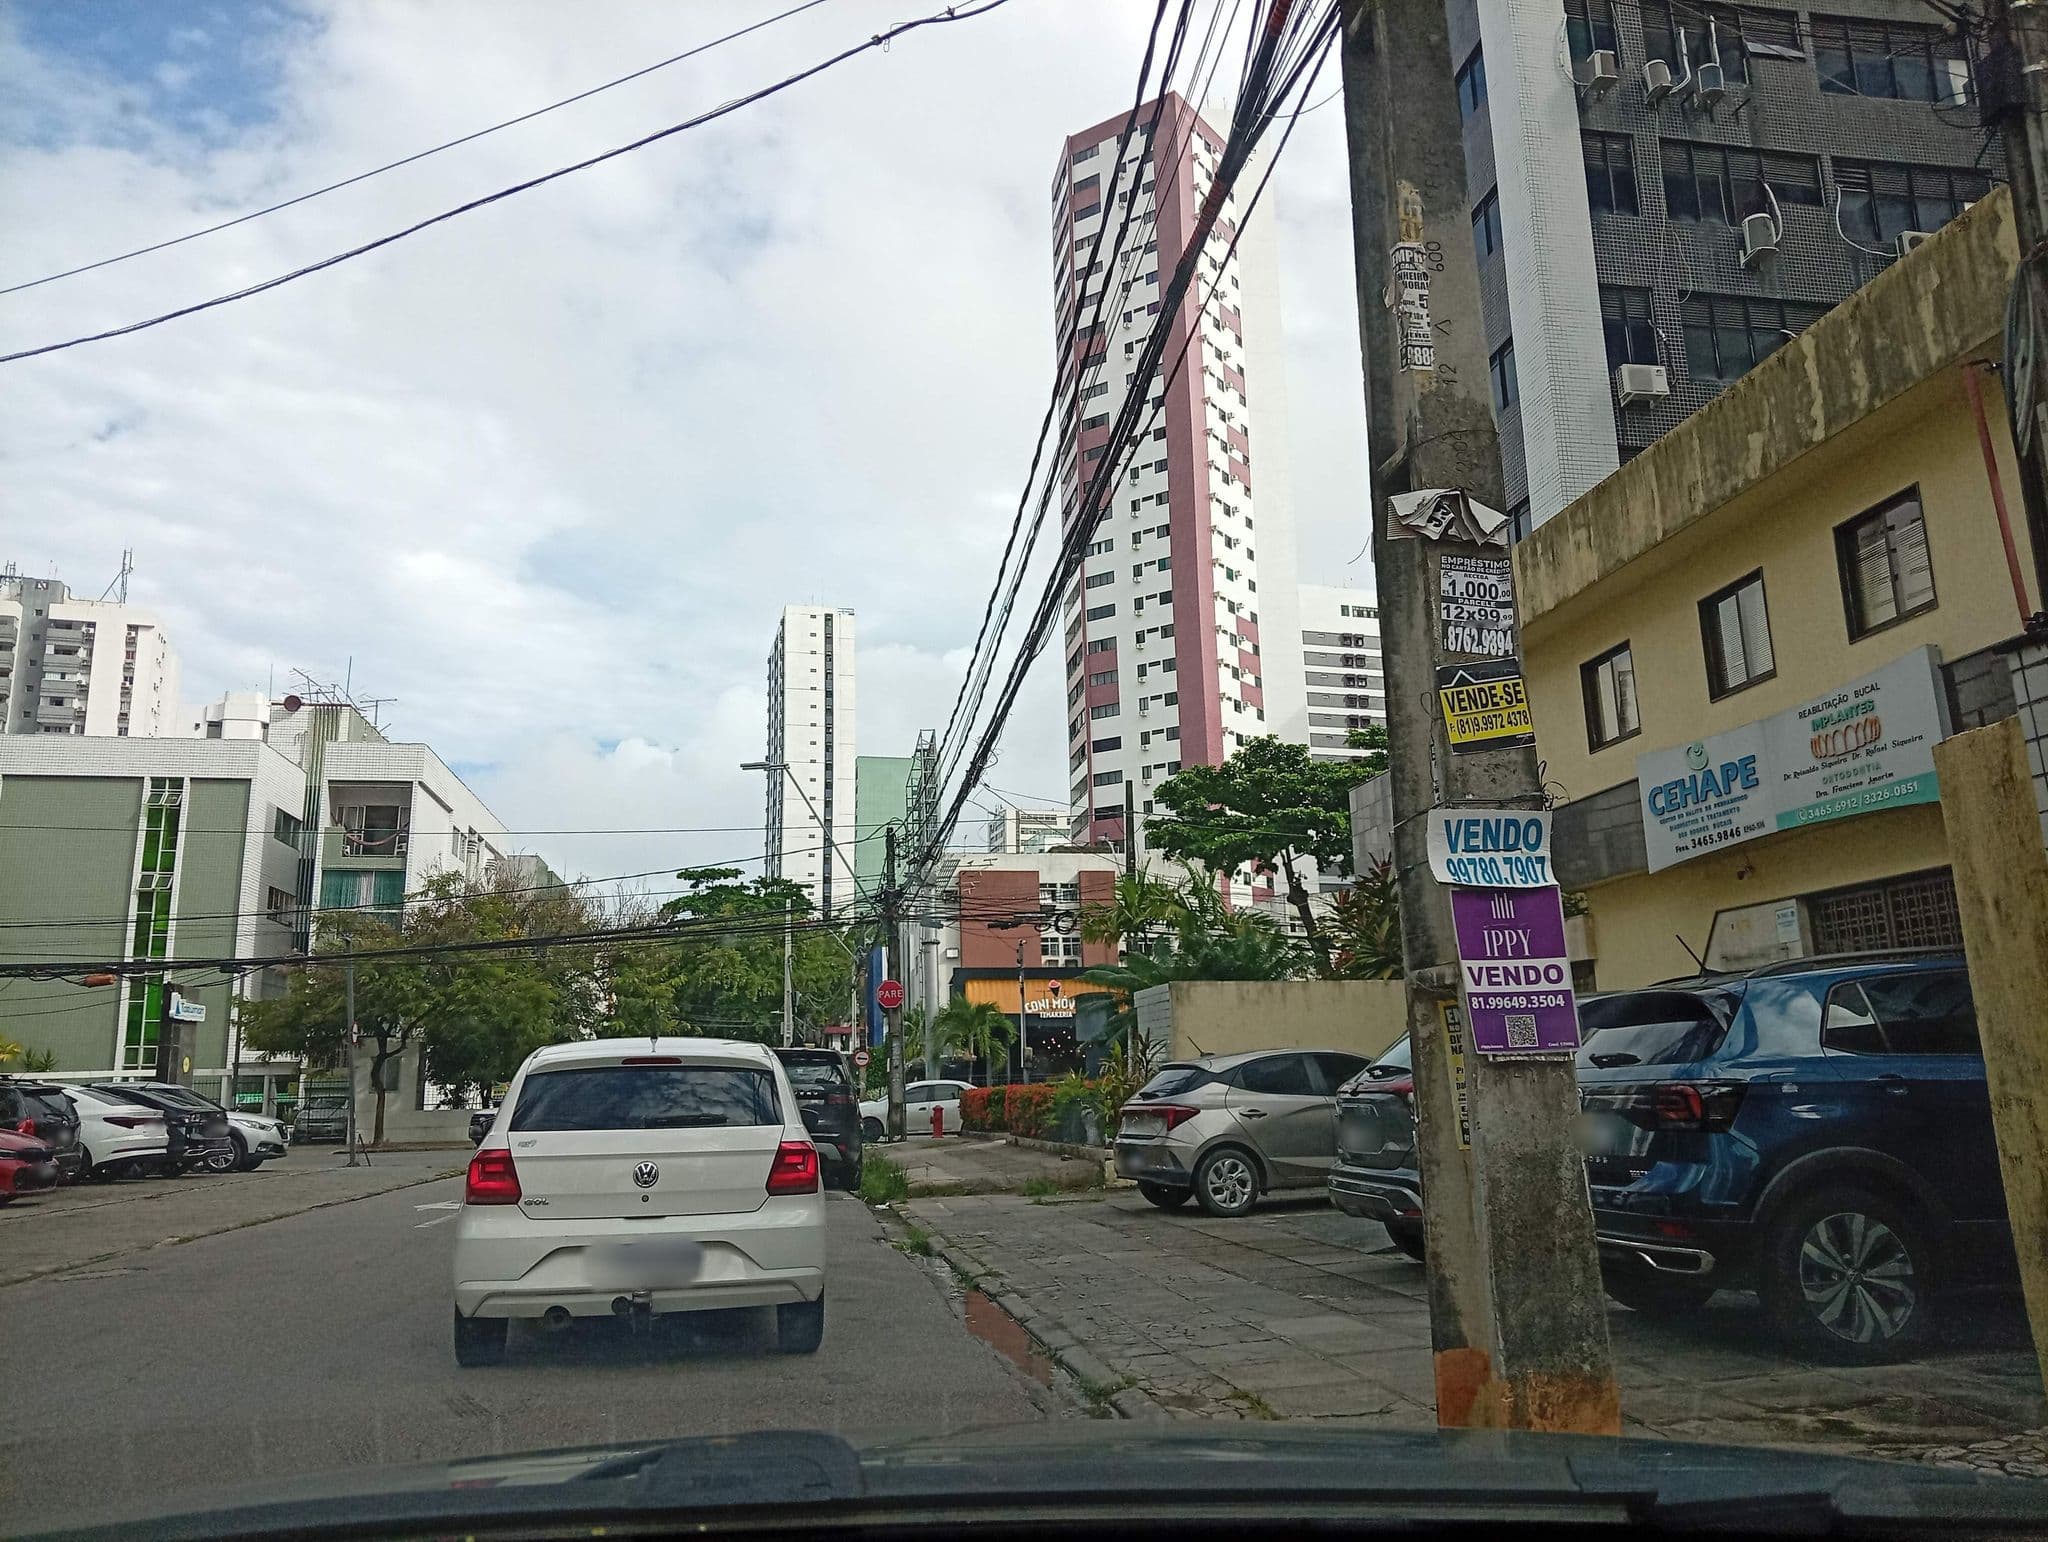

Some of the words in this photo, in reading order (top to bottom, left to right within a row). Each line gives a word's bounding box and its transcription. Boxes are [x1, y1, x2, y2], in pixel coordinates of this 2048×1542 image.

[1441, 555, 1510, 568] EMPRÉSTIMO
[1458, 598, 1497, 608] PARCELE
[1447, 625, 1514, 657] 8762.9894
[1444, 681, 1524, 713] VENDE-SE
[1798, 693, 1849, 720] REABILITAÇÃO
[1853, 682, 1881, 699] BUCAL
[1506, 709, 1530, 728] 4378
[1811, 700, 1876, 732] IMPLANTES
[1820, 757, 1848, 771] Siqueira
[1852, 751, 1862, 761] Dr.
[1865, 743, 1888, 758] Rafael
[1891, 734, 1924, 750] Siqueira
[1648, 754, 1760, 817] CEHAPE
[1444, 817, 1543, 854] VENDO
[1690, 826, 1742, 849] 3465.9846
[1446, 855, 1549, 885] 99780.7907
[1482, 928, 1532, 957] IPPY
[1467, 963, 1564, 987] VENDO
[878, 989, 904, 998] PARE
[1024, 998, 1049, 1013] CONI
[1471, 994, 1565, 1010] 81.99649.3504
